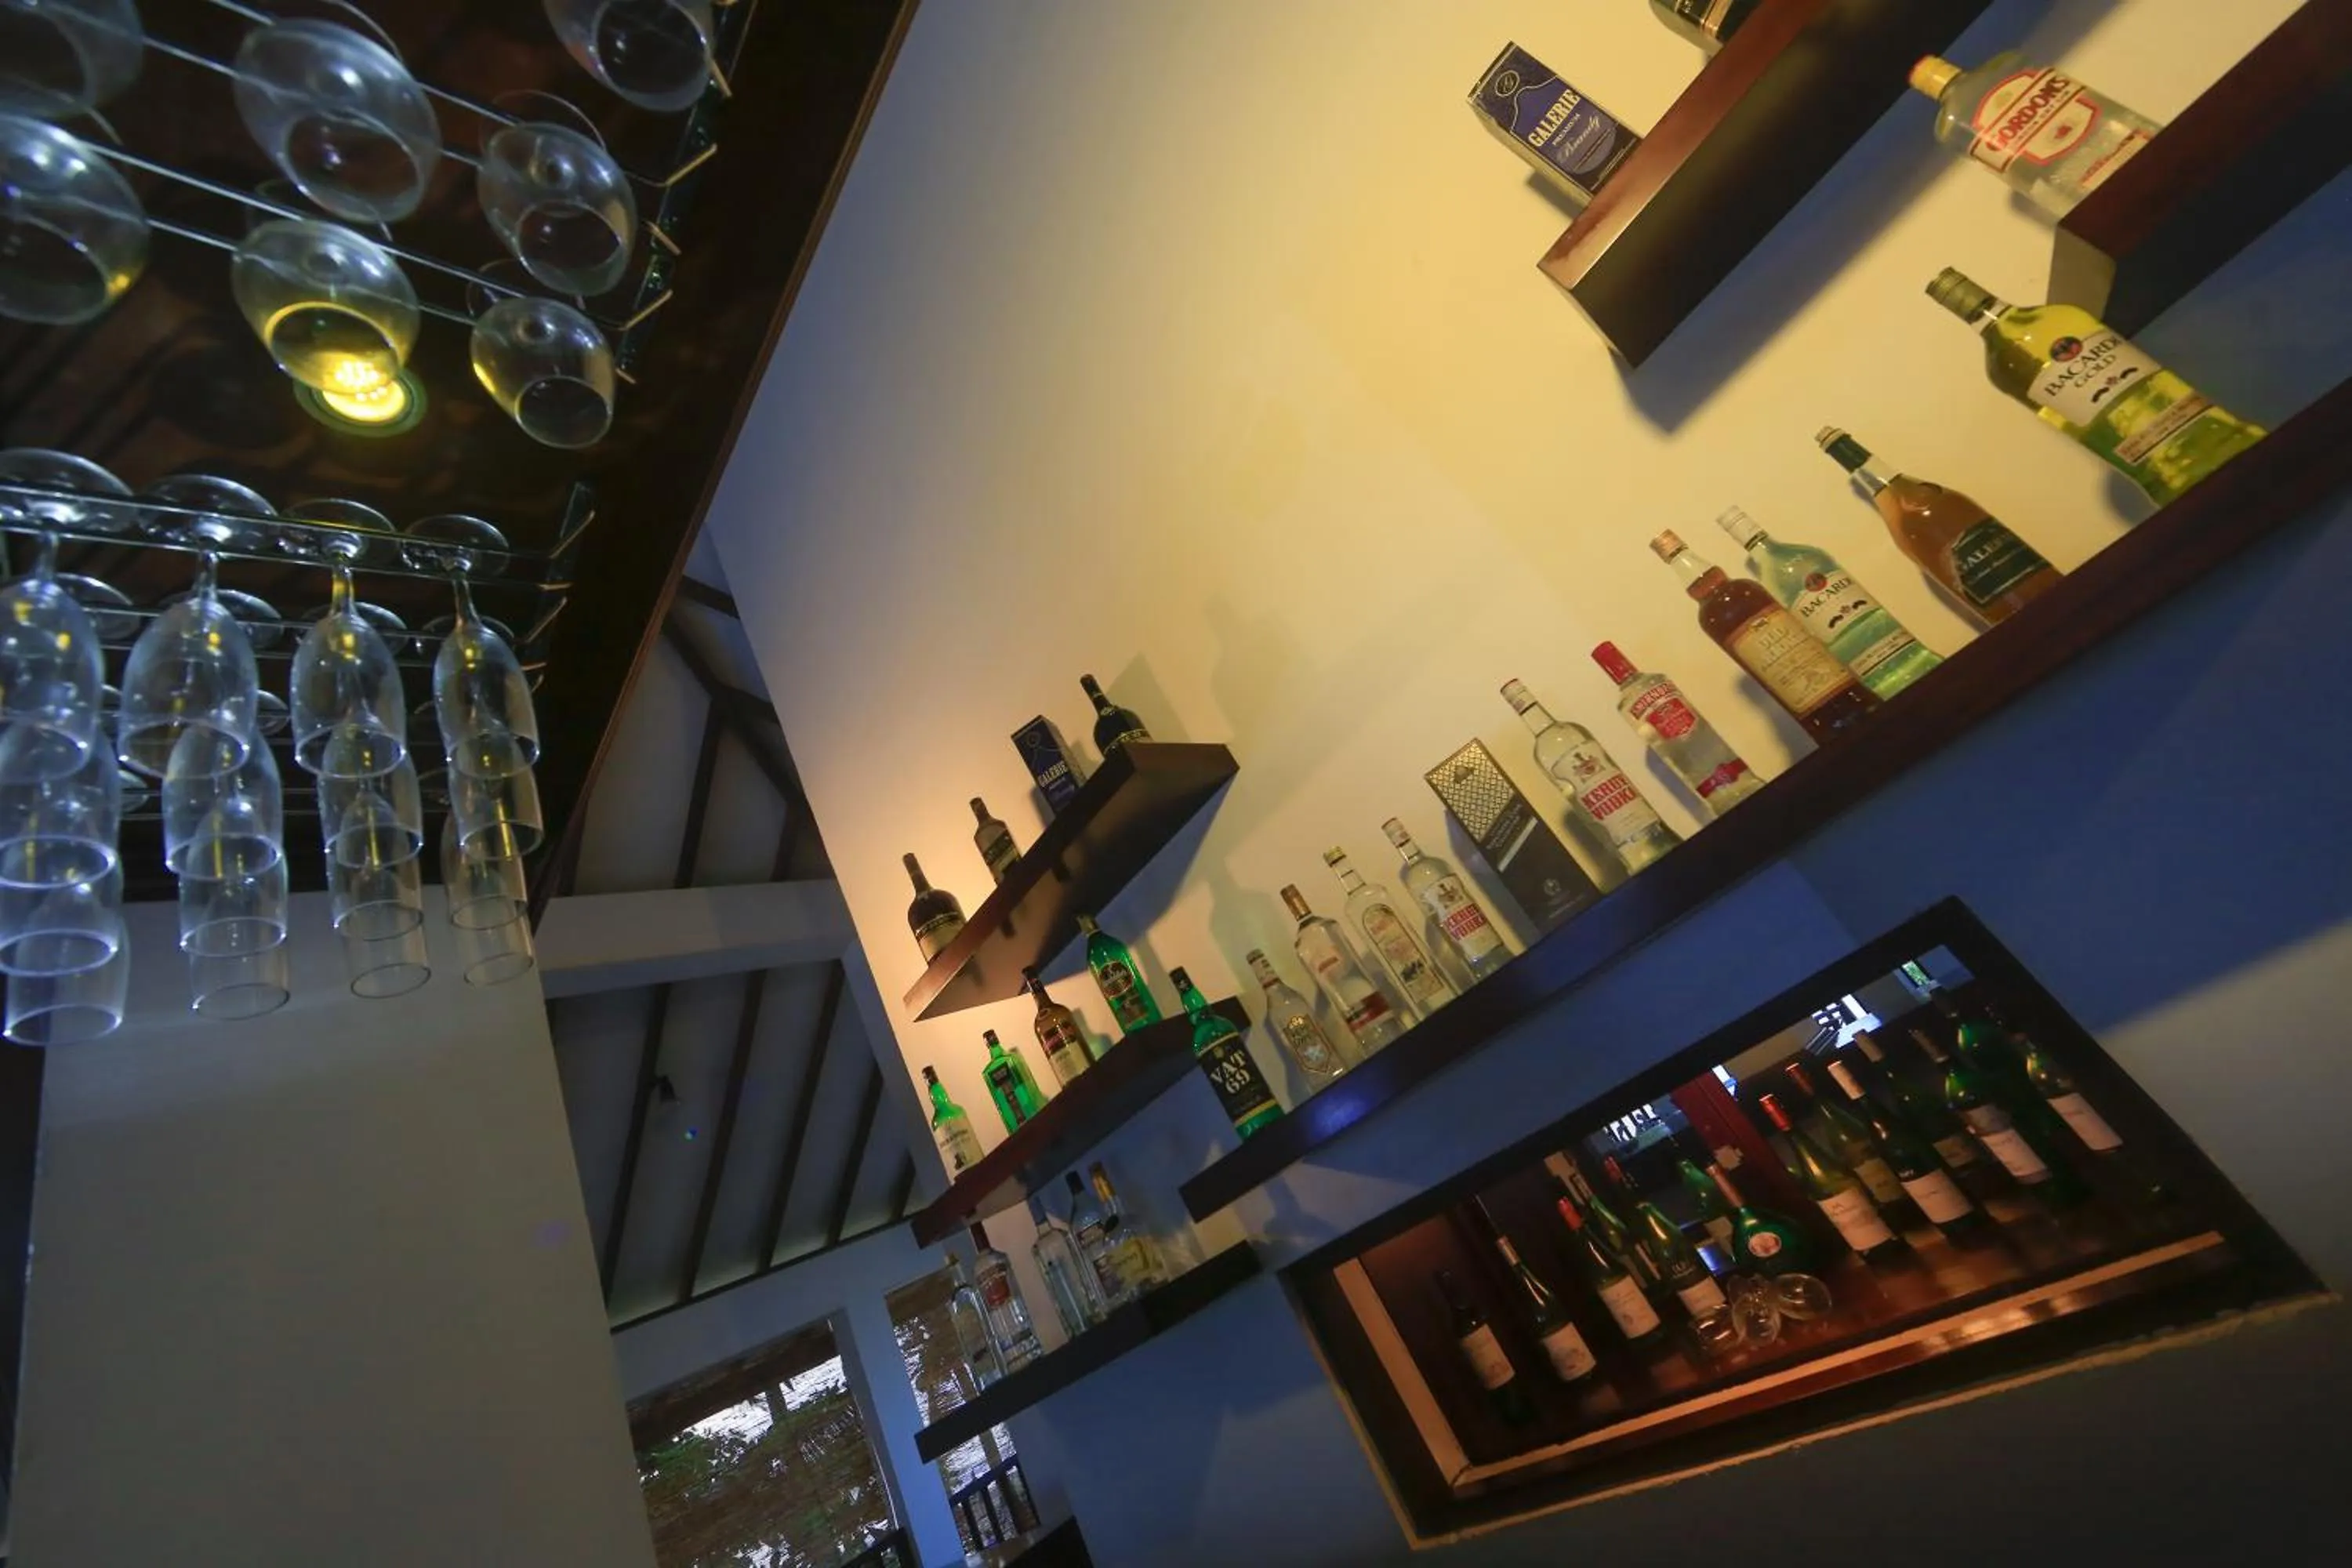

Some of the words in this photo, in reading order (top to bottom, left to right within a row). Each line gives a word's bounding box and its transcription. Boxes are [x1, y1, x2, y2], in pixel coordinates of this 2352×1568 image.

[1528, 89, 1581, 147] GALERIE
[2074, 354, 2117, 387] GOLD
[1210, 1051, 1246, 1084] VAT
[1225, 1068, 1251, 1094] 69
